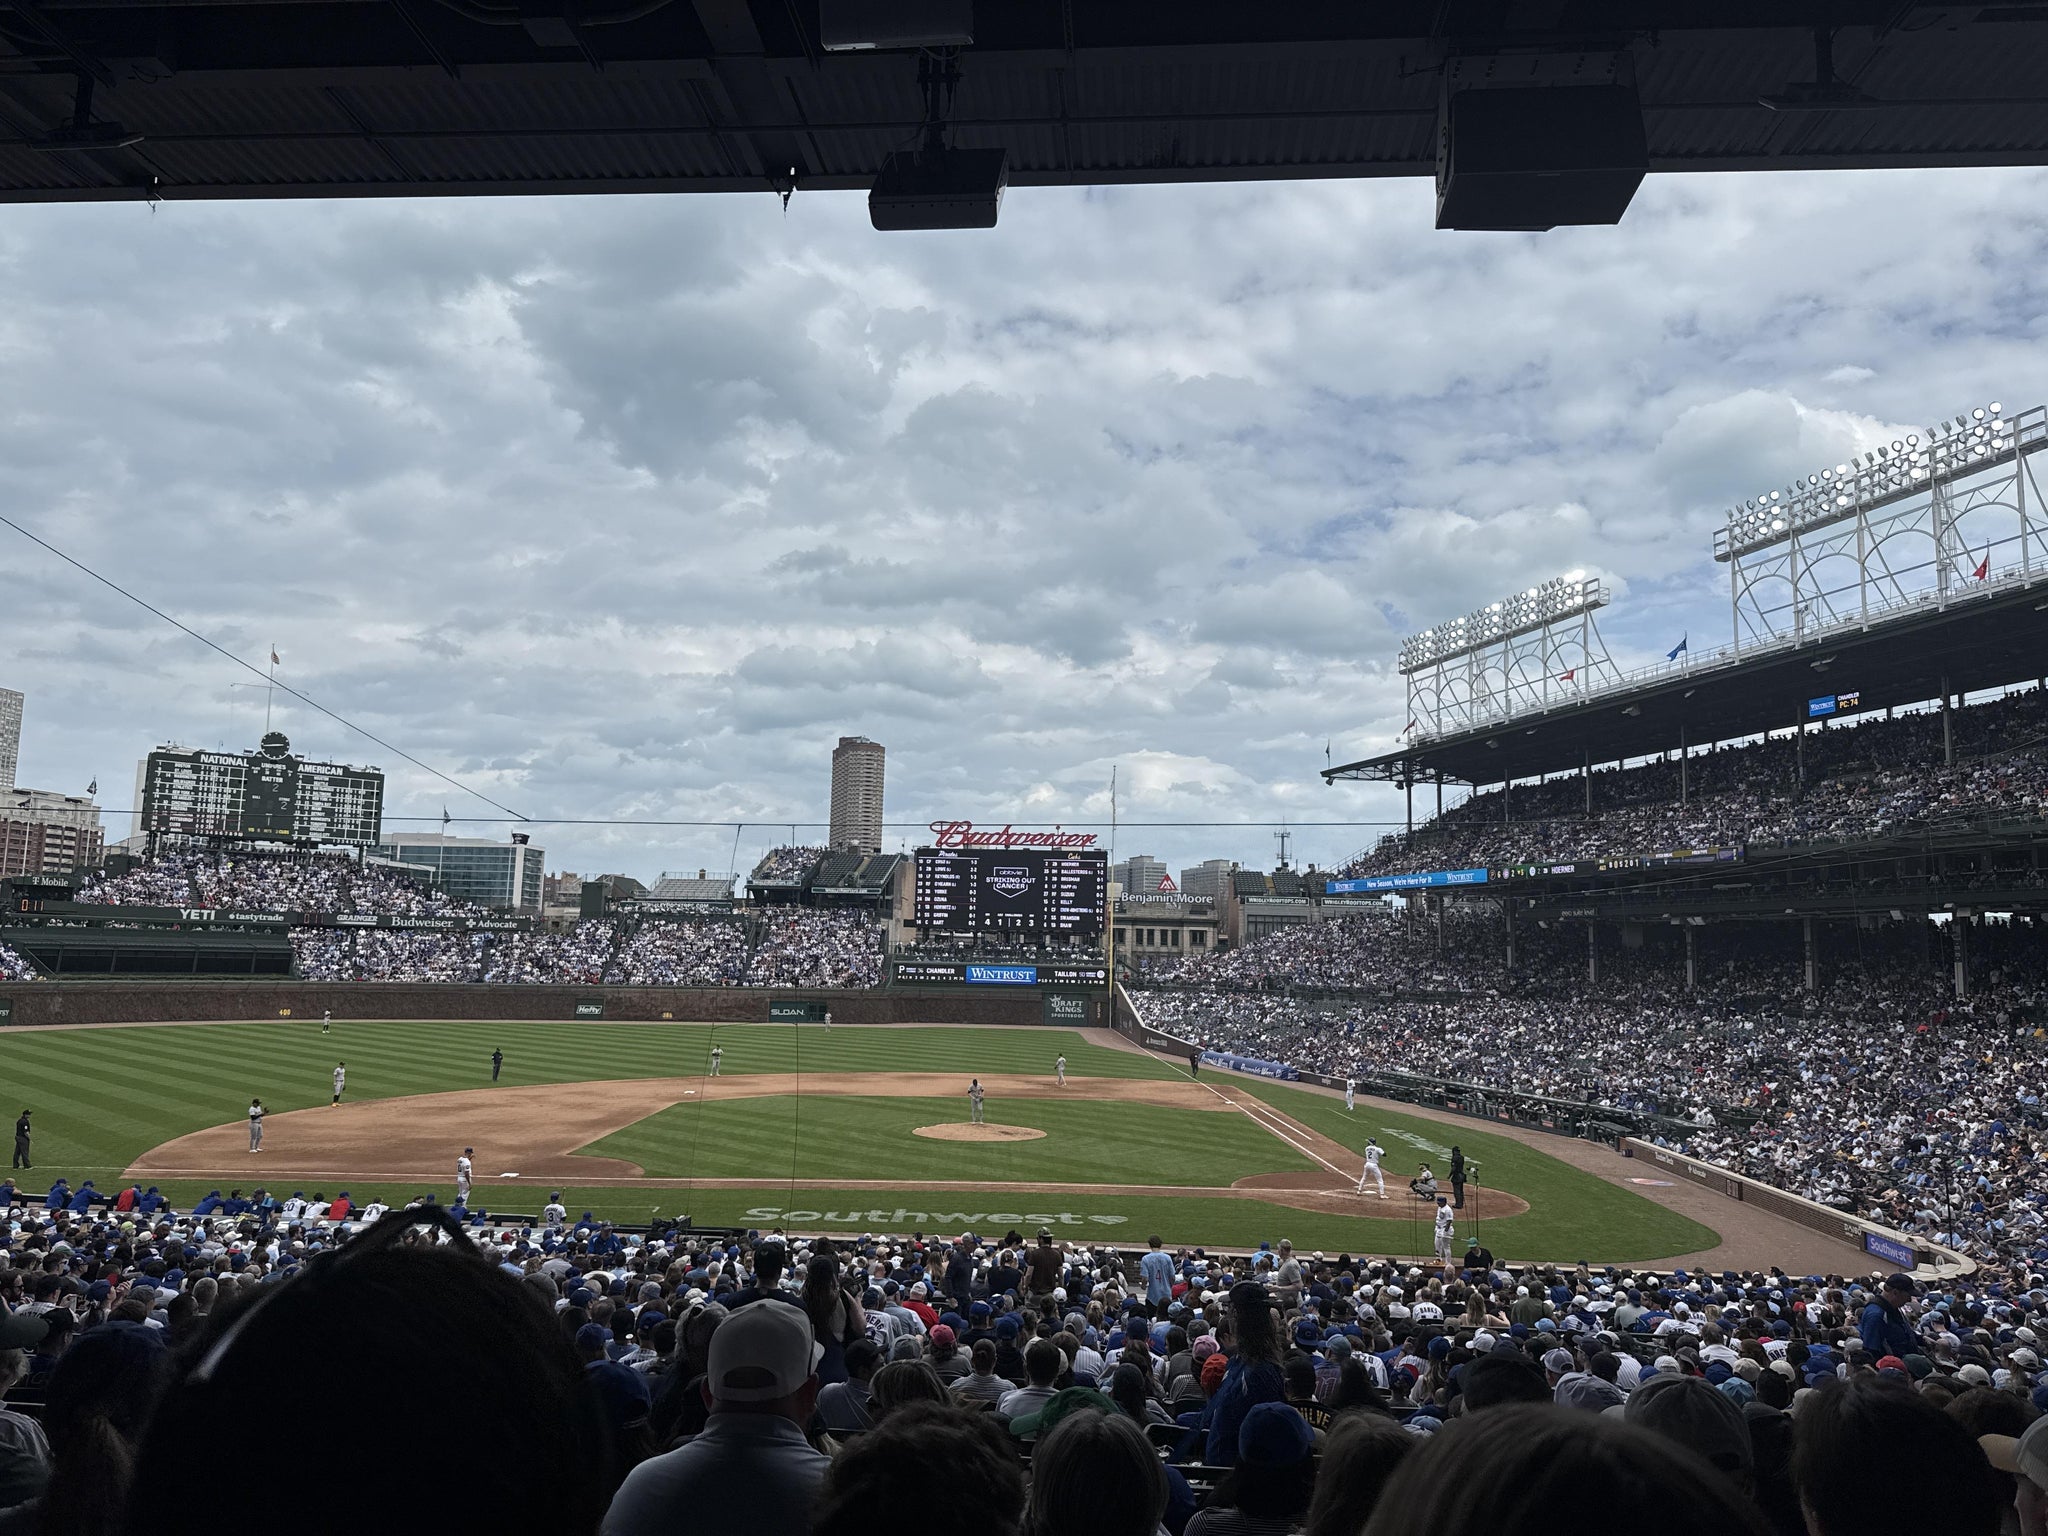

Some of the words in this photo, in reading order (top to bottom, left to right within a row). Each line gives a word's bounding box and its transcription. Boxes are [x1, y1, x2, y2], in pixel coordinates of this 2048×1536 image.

[1838, 692, 1859, 701] CHANDLER
[1850, 698, 1858, 706] 74
[200, 754, 249, 767] NATIONAL
[297, 764, 343, 776] AMERICAN
[273, 783, 280, 792] 2
[281, 801, 288, 810] 2
[929, 821, 1097, 847] Budweiser
[1068, 852, 1080, 860] Cubs
[1551, 865, 1575, 874] HOERNER
[1377, 880, 1393, 888] Season,
[1394, 878, 1406, 886] We're
[1407, 877, 1418, 885] Here
[1419, 876, 1427, 884] For
[1428, 875, 1432, 884] It
[1446, 872, 1475, 881] WINTRUST
[41, 877, 69, 887] Mobile
[1121, 892, 1173, 905] Benjamin
[1176, 893, 1213, 904] Moore
[180, 908, 216, 920] YETI
[235, 912, 285, 922] tastytrade
[336, 914, 378, 922] GRAINGER
[392, 917, 452, 928] Budweiser
[477, 921, 517, 929] Advocate
[984, 918, 991, 926] 4
[997, 918, 1002, 926] 1
[1015, 919, 1021, 927] 2
[1028, 919, 1034, 927] 3
[899, 965, 905, 973] P
[971, 968, 1032, 980] WINTRUST
[1052, 1000, 1083, 1008] DRAFT
[579, 1005, 600, 1014] Hefty
[1367, 1150, 1373, 1159] 2
[283, 1202, 295, 1212] 20
[547, 1211, 554, 1222] 3
[739, 1208, 1084, 1226] Southwest
[1870, 1237, 1907, 1263] Southwest
[1156, 1269, 1162, 1281] 4
